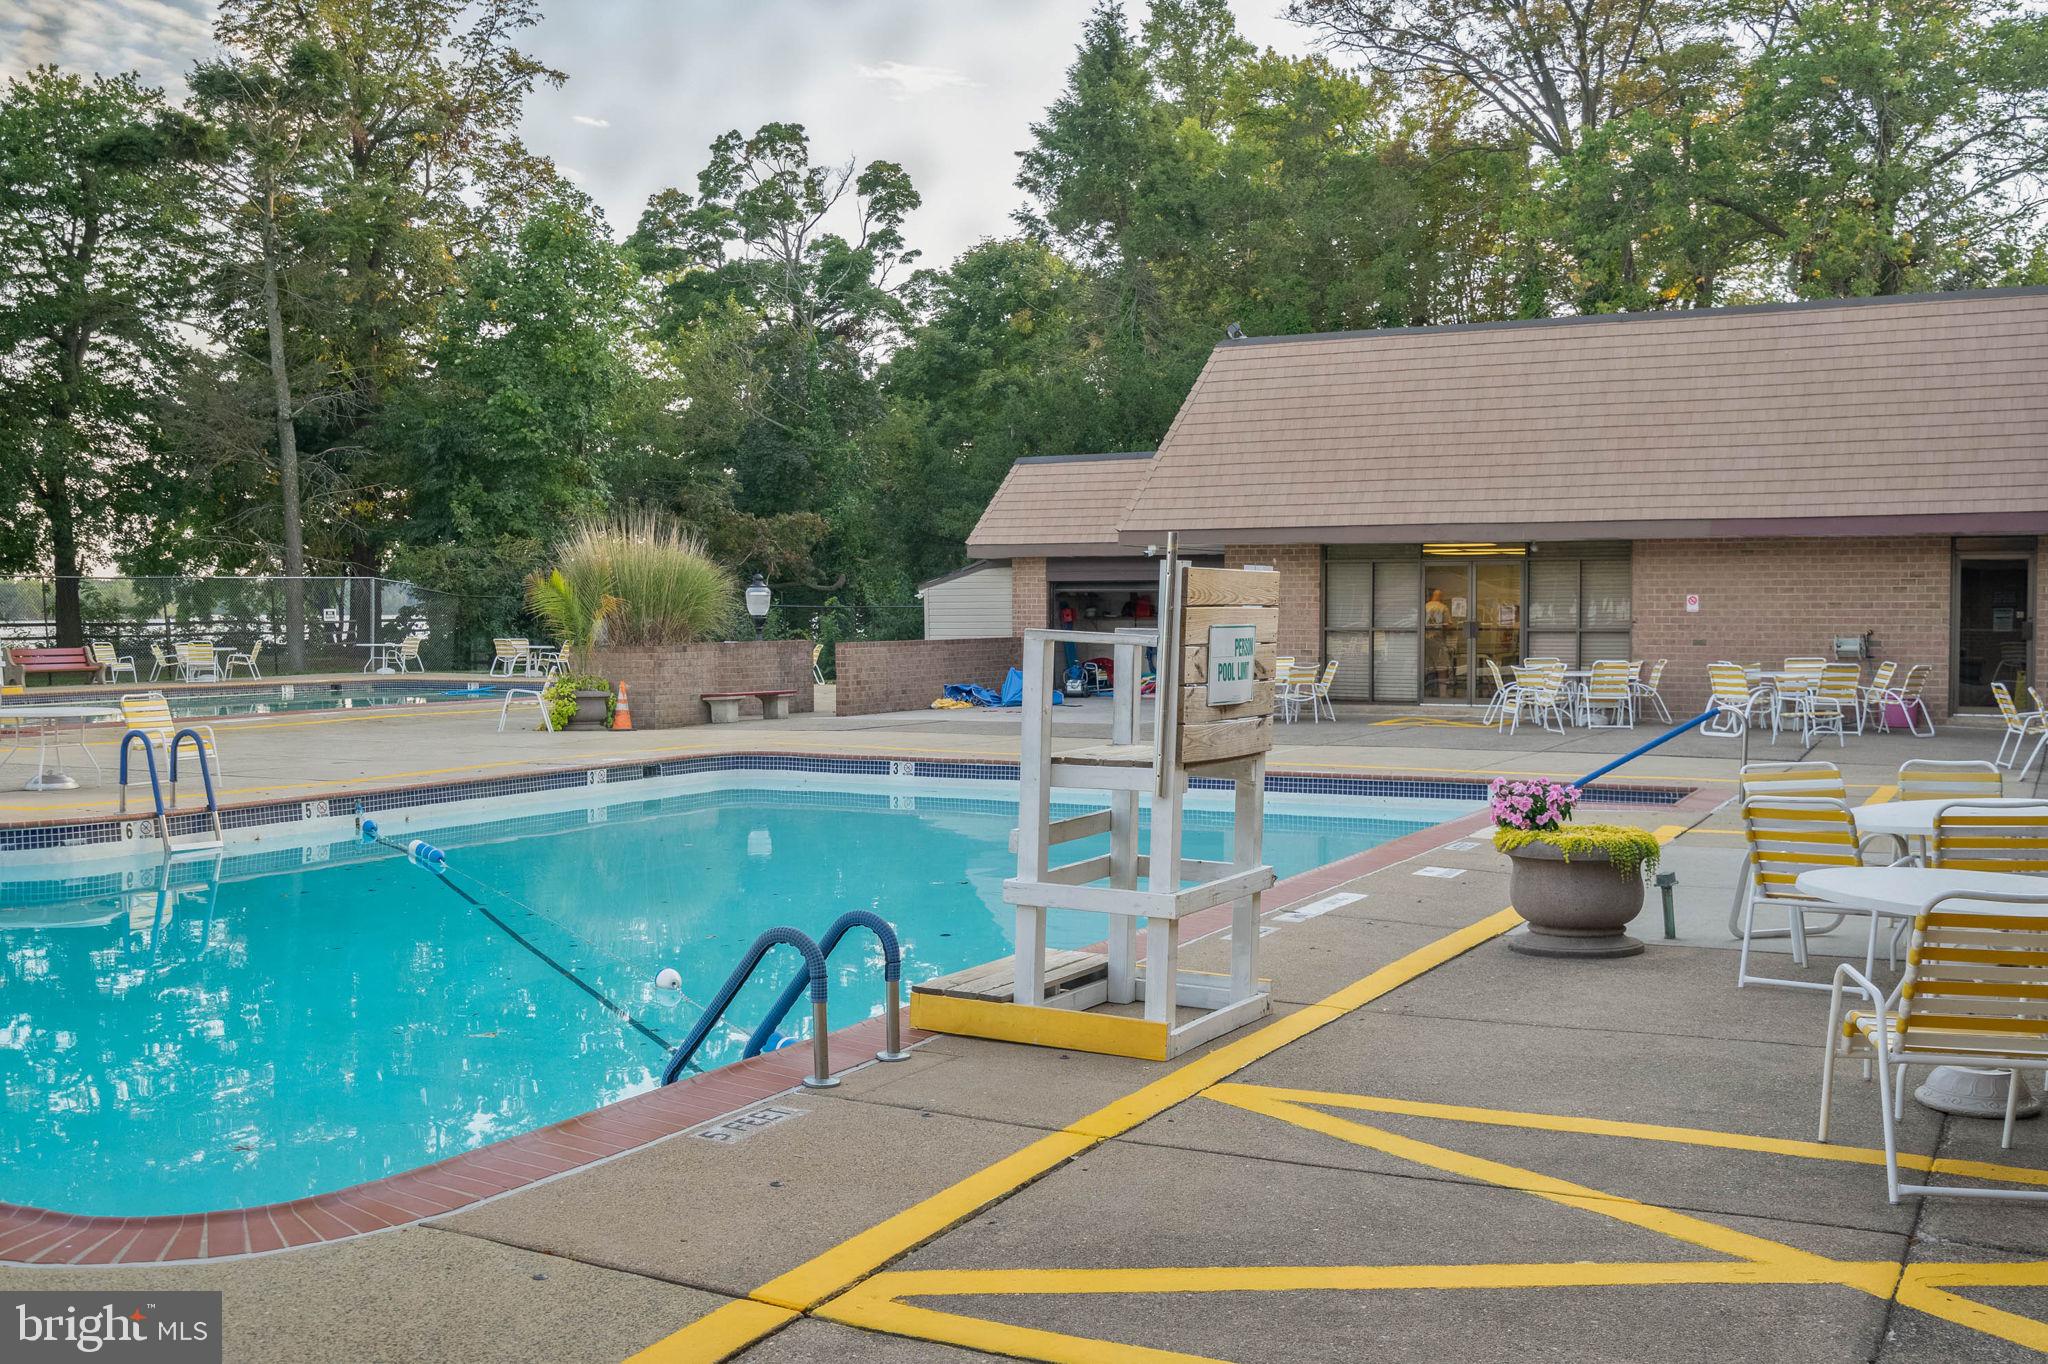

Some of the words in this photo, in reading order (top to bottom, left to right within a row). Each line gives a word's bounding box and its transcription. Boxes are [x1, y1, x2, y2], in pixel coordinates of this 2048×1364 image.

[1217, 662, 1236, 682] POOL
[893, 762, 899, 775] 3
[305, 803, 312, 819] 5
[126, 823, 133, 840] 6
[699, 1131, 730, 1141] 5
[722, 1107, 791, 1132] FEET
